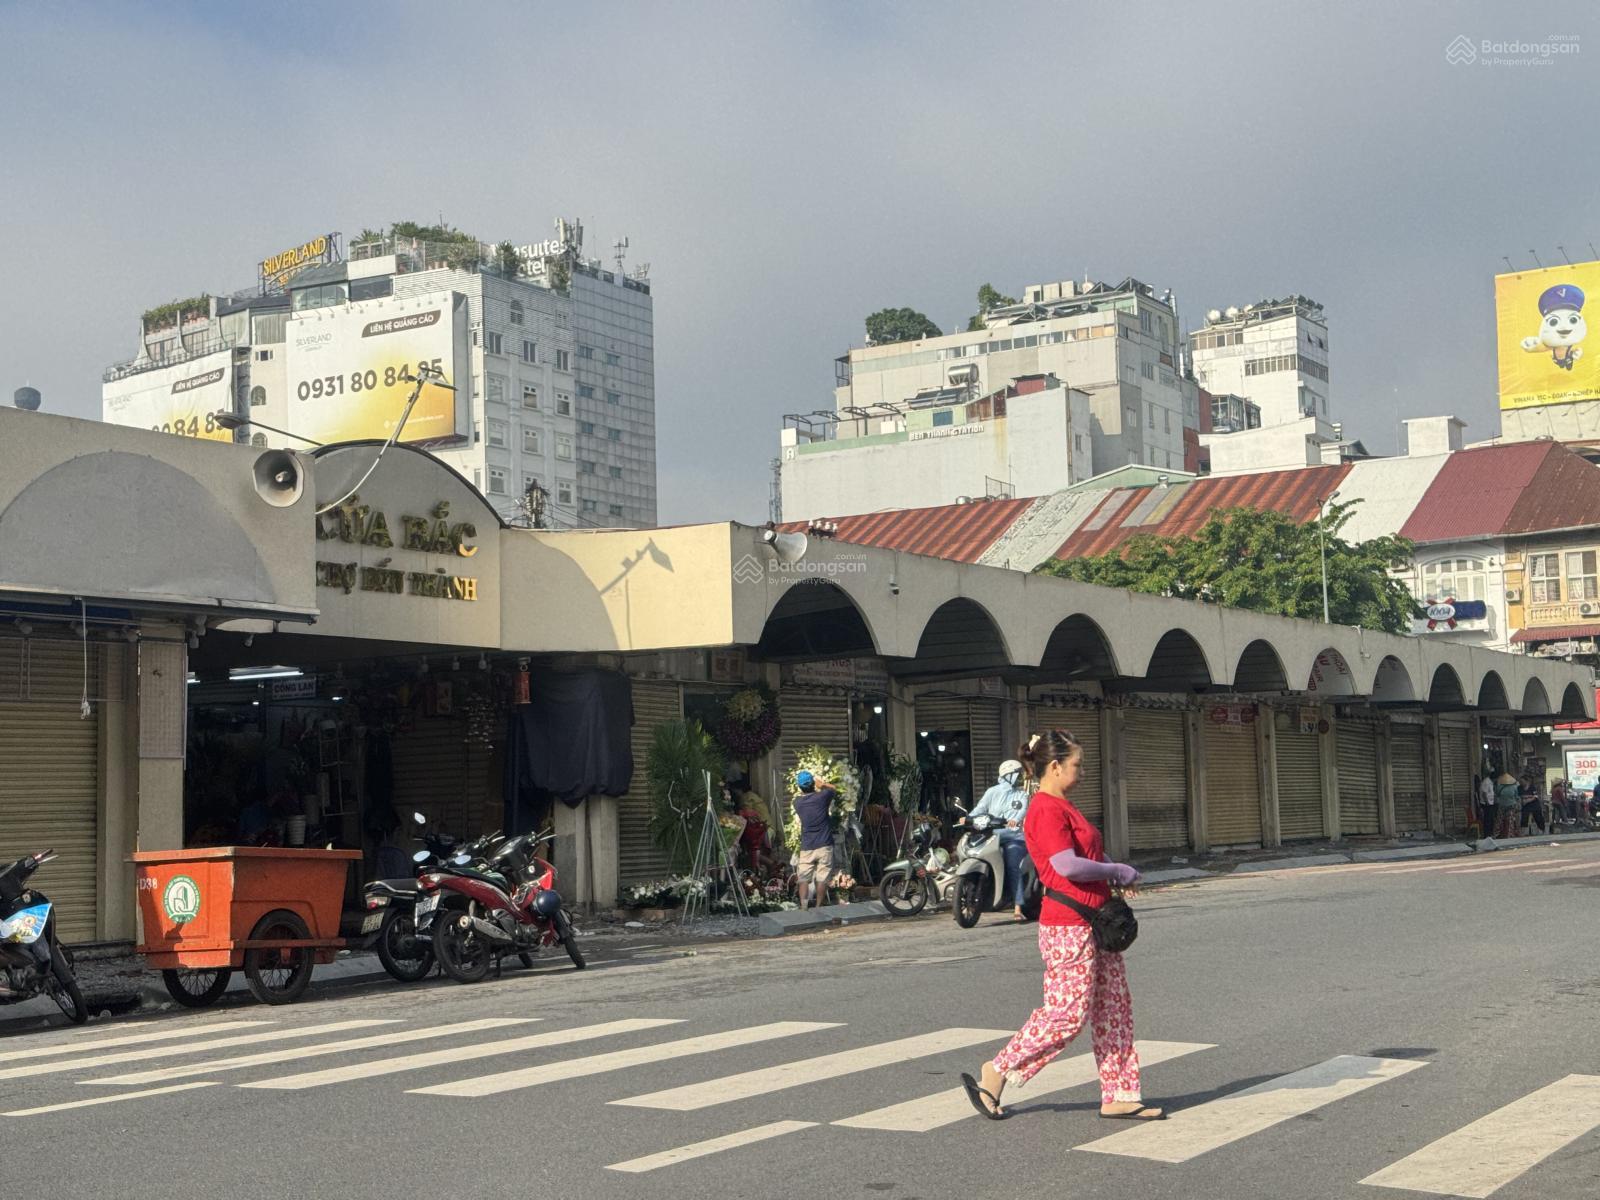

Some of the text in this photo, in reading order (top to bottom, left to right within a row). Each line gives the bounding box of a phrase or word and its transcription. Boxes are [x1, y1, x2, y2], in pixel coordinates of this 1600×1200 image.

[263, 235, 326, 276] SILVERLAND
[297, 375, 344, 401] 0931
[351, 369, 377, 393] 80
[384, 364, 410, 388] 84
[174, 416, 199, 437] 84
[401, 500, 478, 557] BẮC
[408, 567, 477, 600] THÀNH
[1575, 760, 1597, 769] 300
